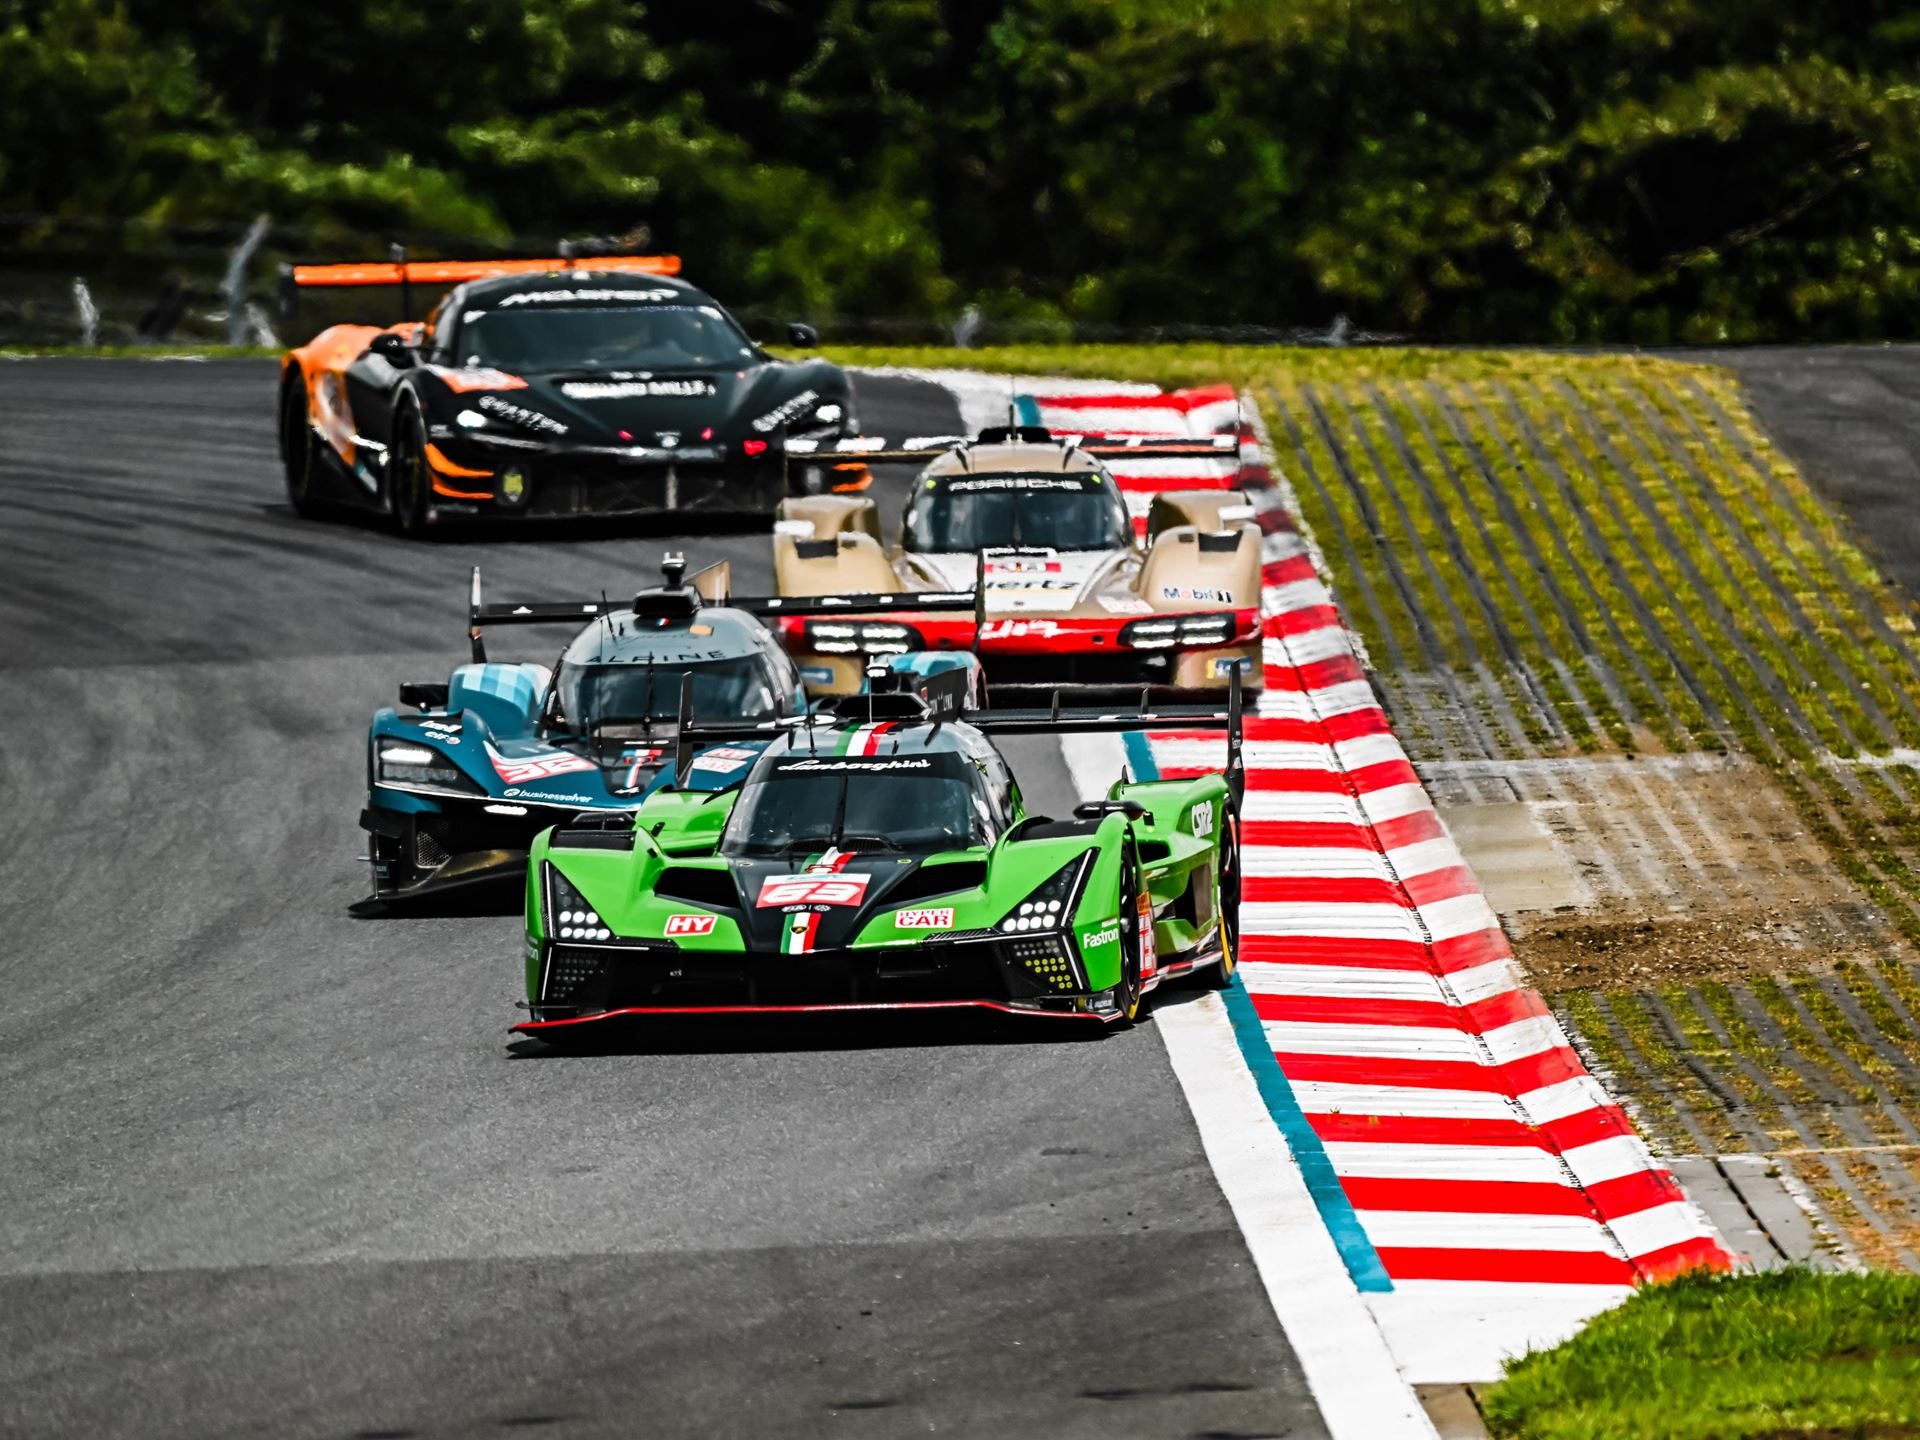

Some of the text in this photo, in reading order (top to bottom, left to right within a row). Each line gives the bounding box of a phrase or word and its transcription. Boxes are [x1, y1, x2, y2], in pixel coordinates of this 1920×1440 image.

[1163, 587, 1213, 600] Mobil
[585, 650, 726, 663] ALPINE
[777, 759, 931, 771] Lamborghini
[520, 789, 593, 803] businessolver
[763, 882, 861, 904] 63
[669, 917, 713, 932] HY
[899, 915, 949, 926] CAR
[1083, 927, 1119, 949] Fastron
